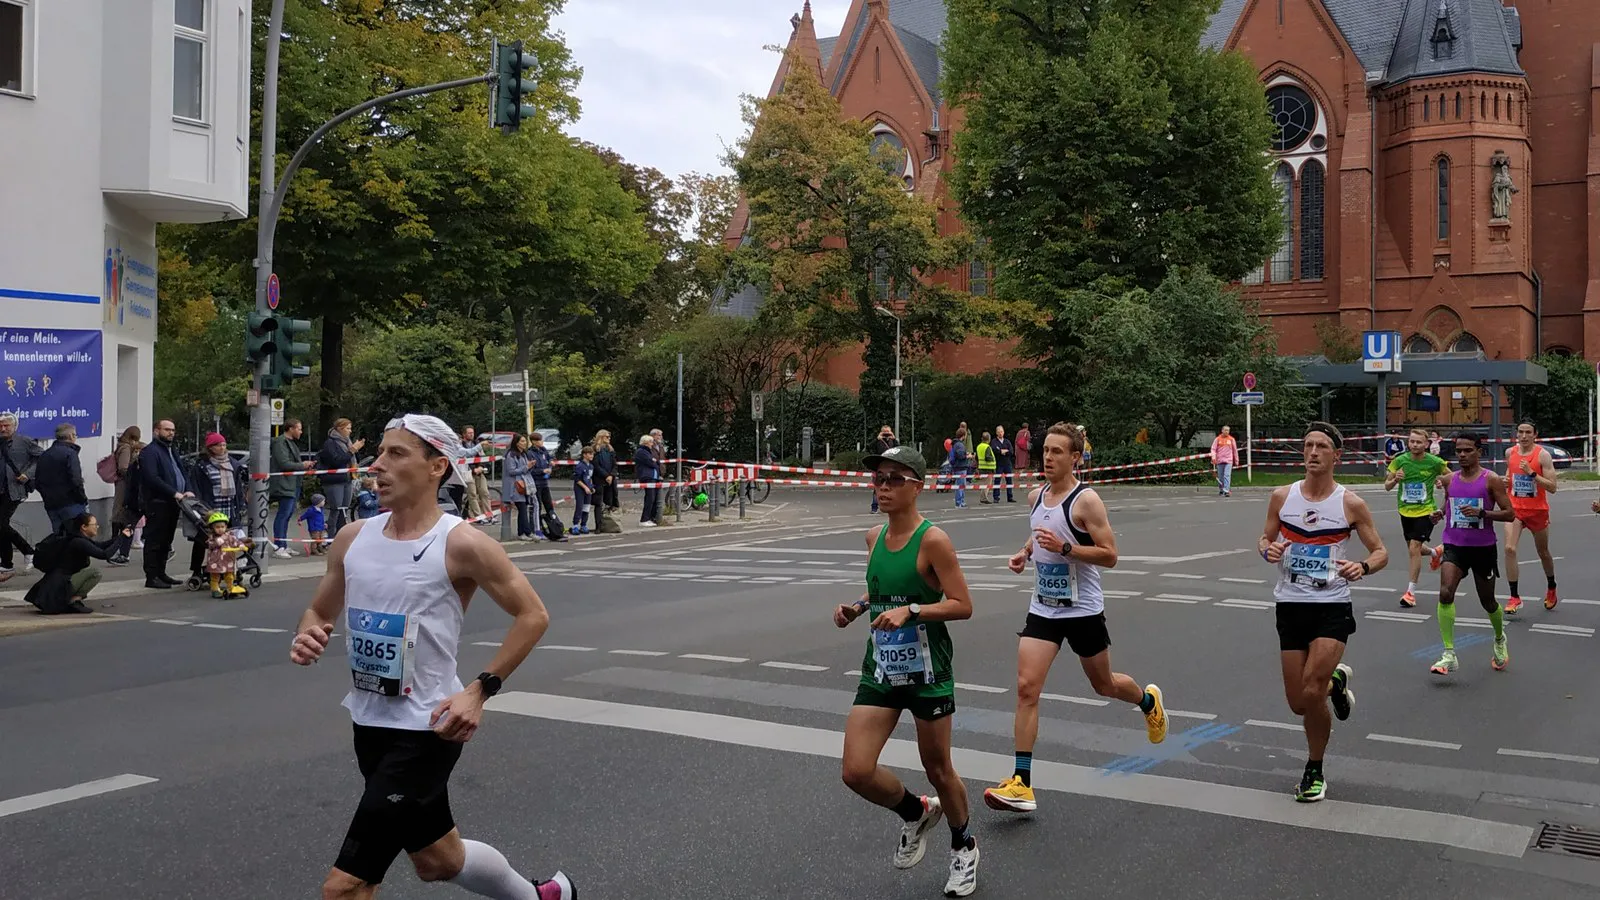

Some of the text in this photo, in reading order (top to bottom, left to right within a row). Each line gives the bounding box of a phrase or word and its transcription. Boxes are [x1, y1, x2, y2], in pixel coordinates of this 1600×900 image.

[10, 332, 29, 343] eine
[33, 331, 61, 344] Meile.
[1368, 334, 1388, 358] U
[4, 350, 63, 362] kennenlernen
[15, 407, 30, 419] das
[33, 407, 58, 421] ewige
[61, 406, 90, 417] Leben.
[1291, 557, 1327, 570] 28674
[890, 595, 907, 603] MAX
[352, 636, 397, 661] 12865
